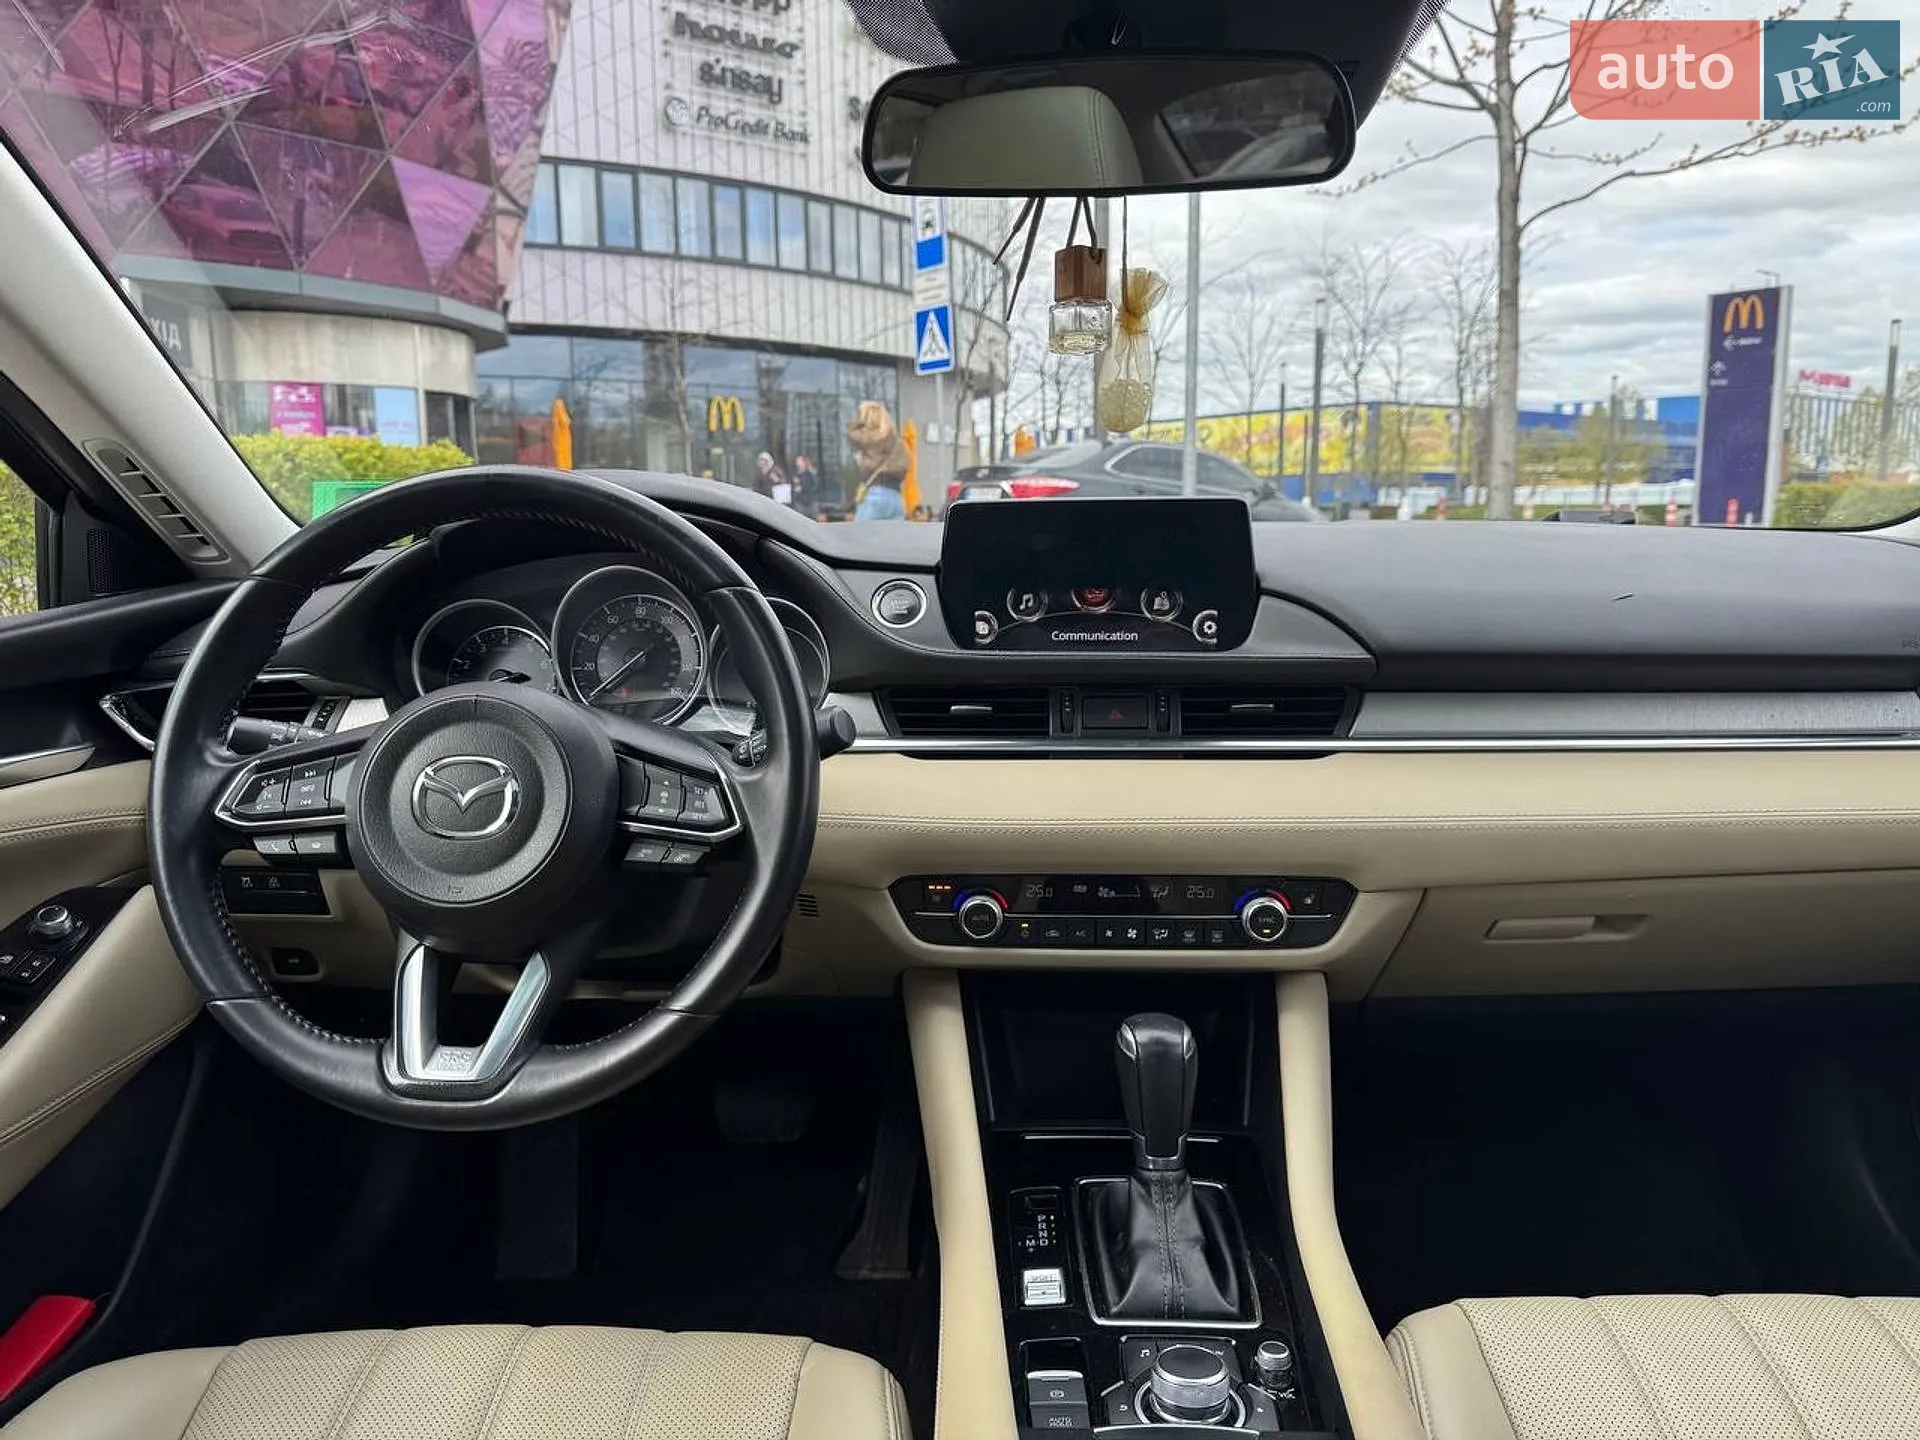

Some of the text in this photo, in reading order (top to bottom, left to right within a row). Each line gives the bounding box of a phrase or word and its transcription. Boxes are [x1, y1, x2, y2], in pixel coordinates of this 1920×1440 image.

[696, 106, 809, 144] ProCredit Bank
[1051, 631, 1139, 642] Communication
[1025, 1238, 1049, 1247] M D
